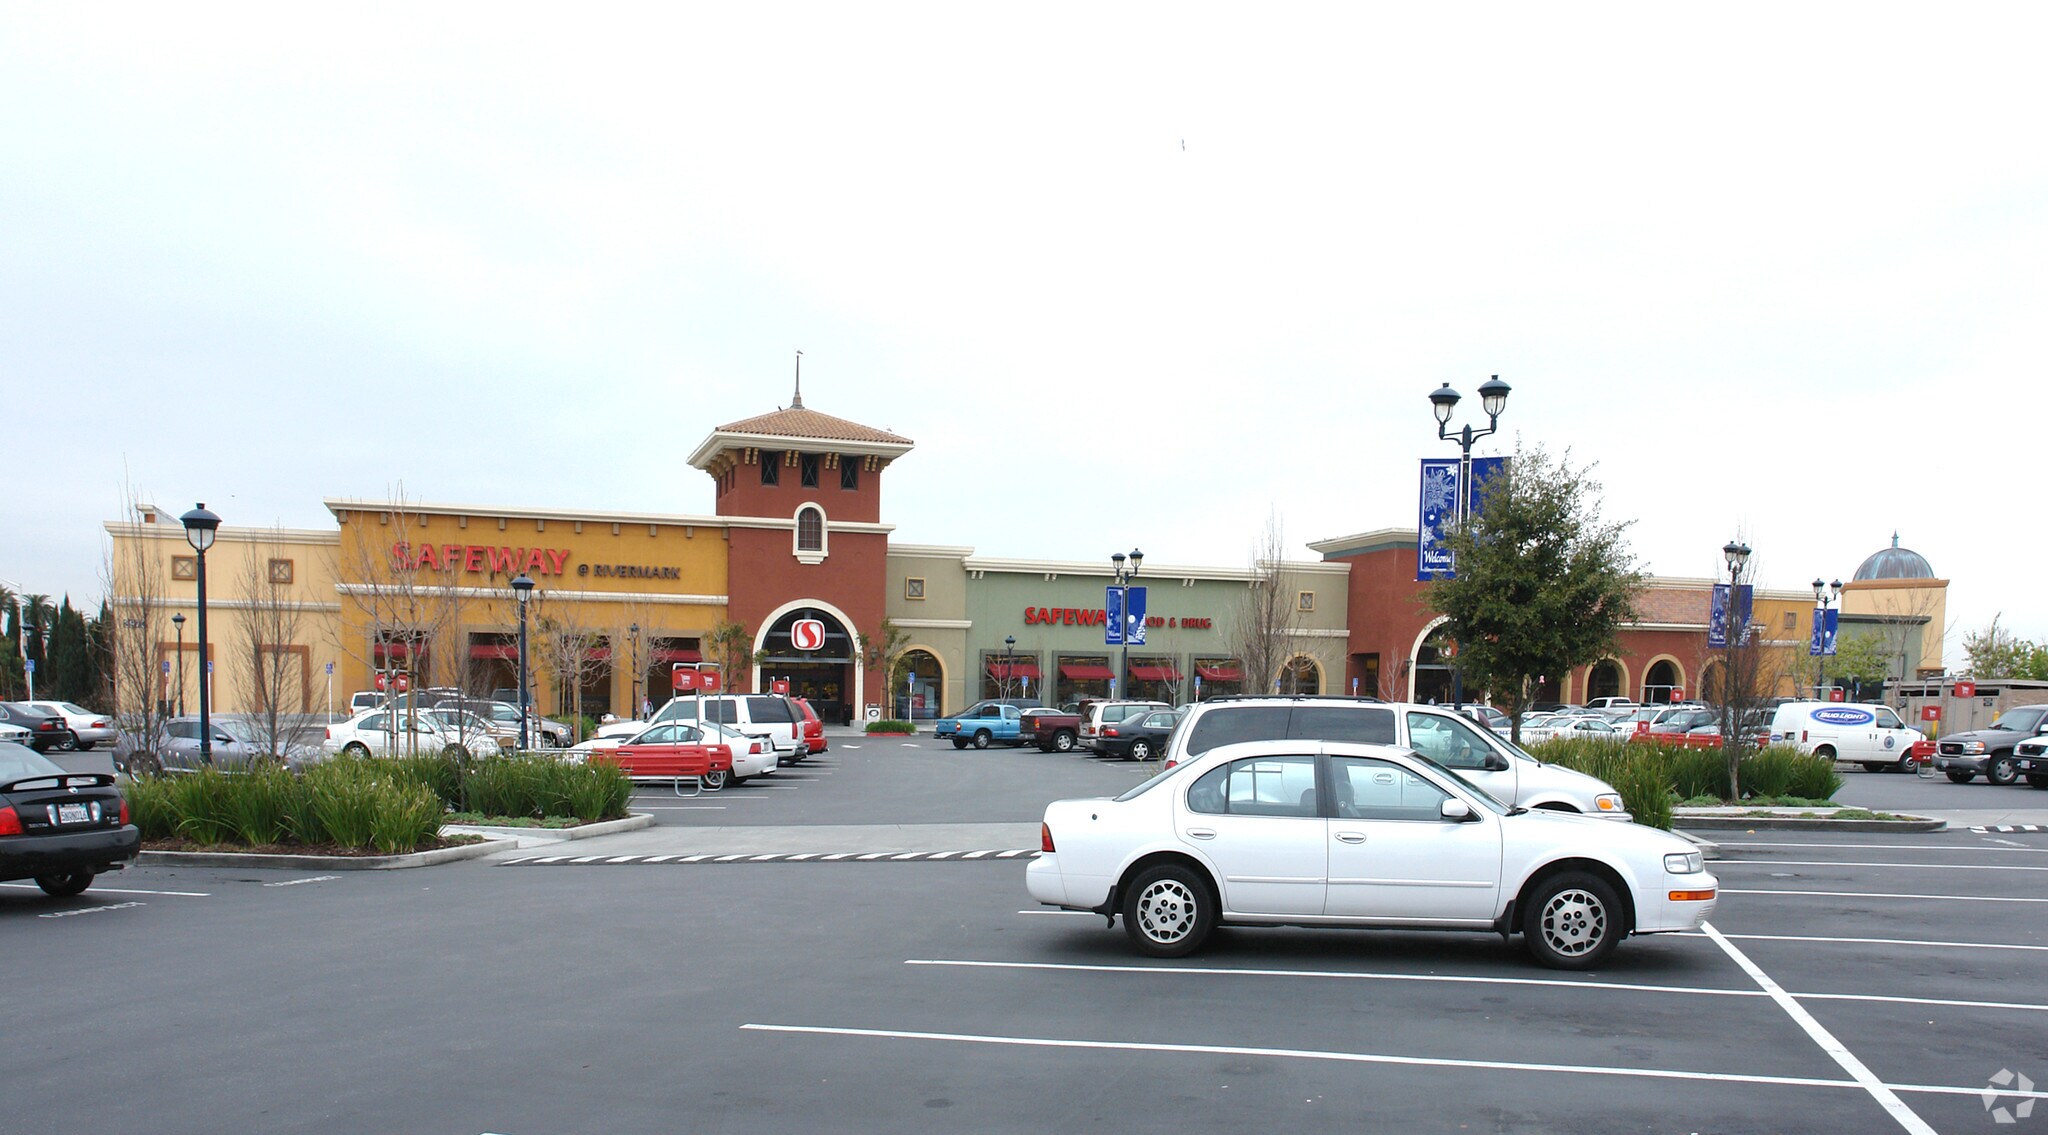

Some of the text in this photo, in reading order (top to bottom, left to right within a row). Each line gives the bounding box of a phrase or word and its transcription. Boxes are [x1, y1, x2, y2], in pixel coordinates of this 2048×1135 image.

[393, 541, 681, 580] SAFEWAY @ RIVERMARK
[1423, 550, 1452, 564] Welcome
[1024, 606, 1106, 626] SAFEWA
[1168, 617, 1177, 629] &
[1181, 617, 1212, 630] DRUG
